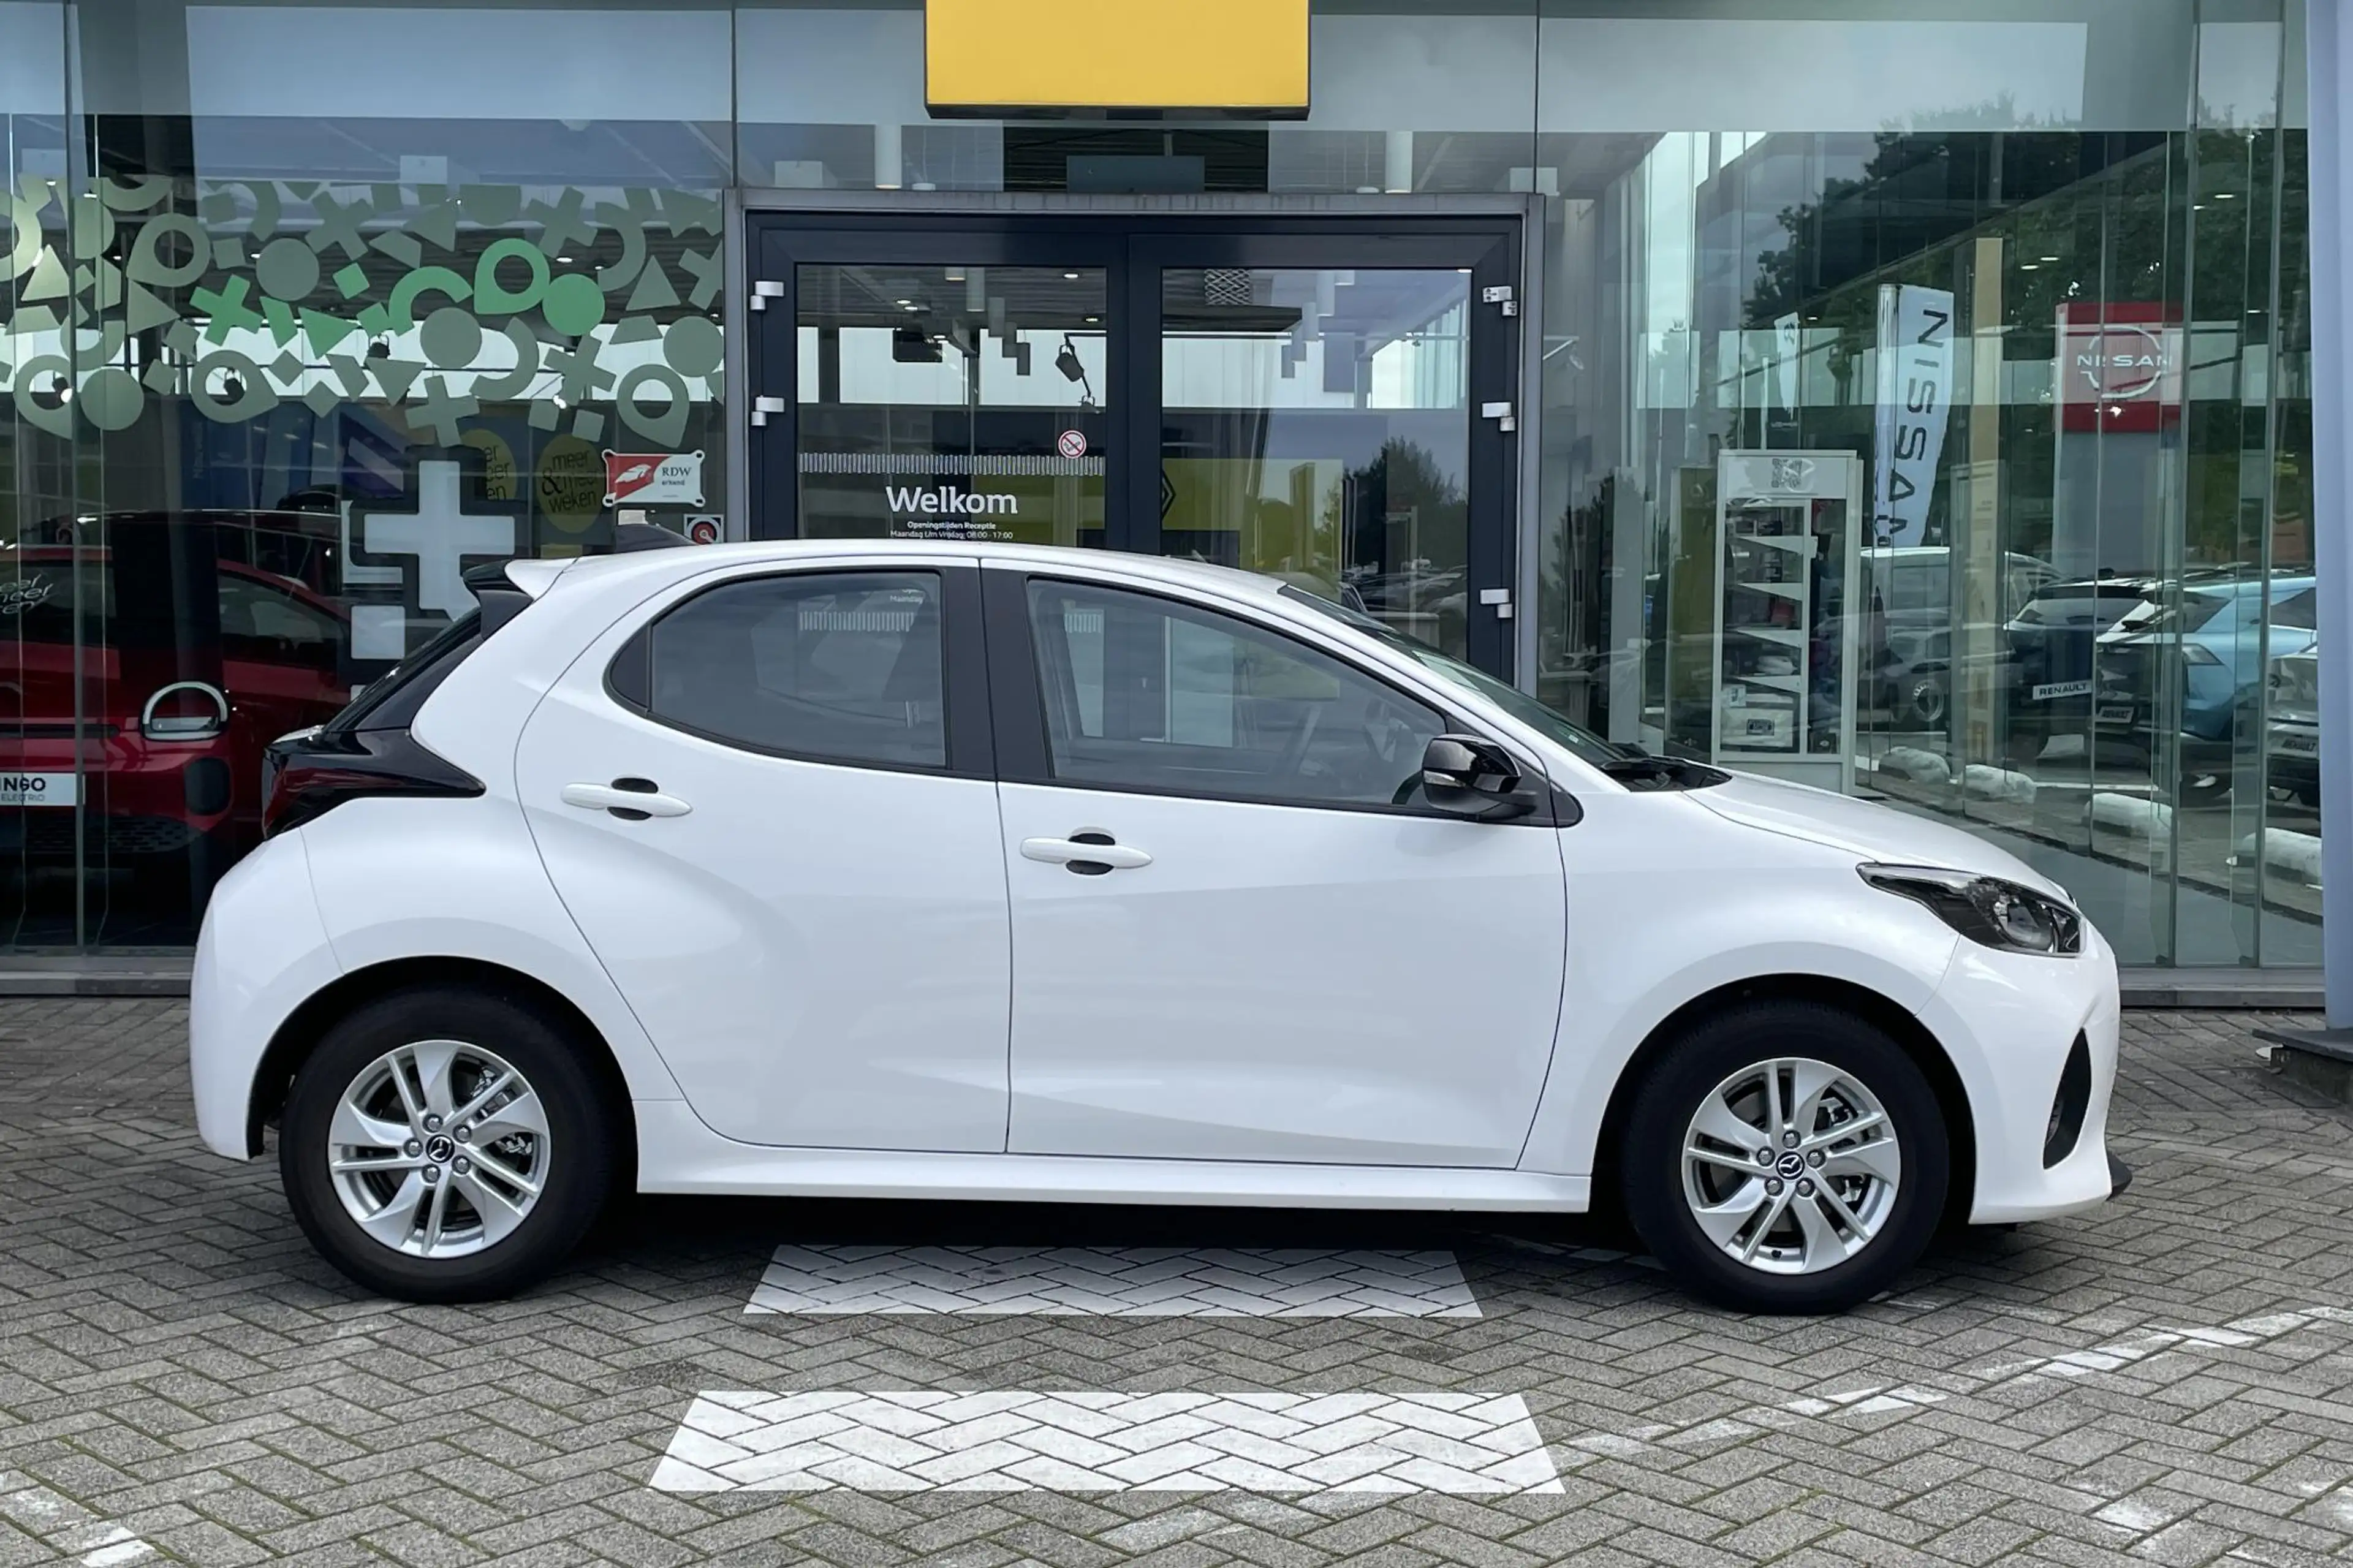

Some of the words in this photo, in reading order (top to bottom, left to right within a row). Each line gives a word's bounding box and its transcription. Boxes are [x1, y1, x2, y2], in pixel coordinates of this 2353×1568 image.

[662, 467, 692, 476] RDW
[548, 491, 597, 513] weken
[885, 486, 1018, 513] Welkom
[890, 530, 923, 539] Maandag
[2039, 683, 2086, 696] RENAULT
